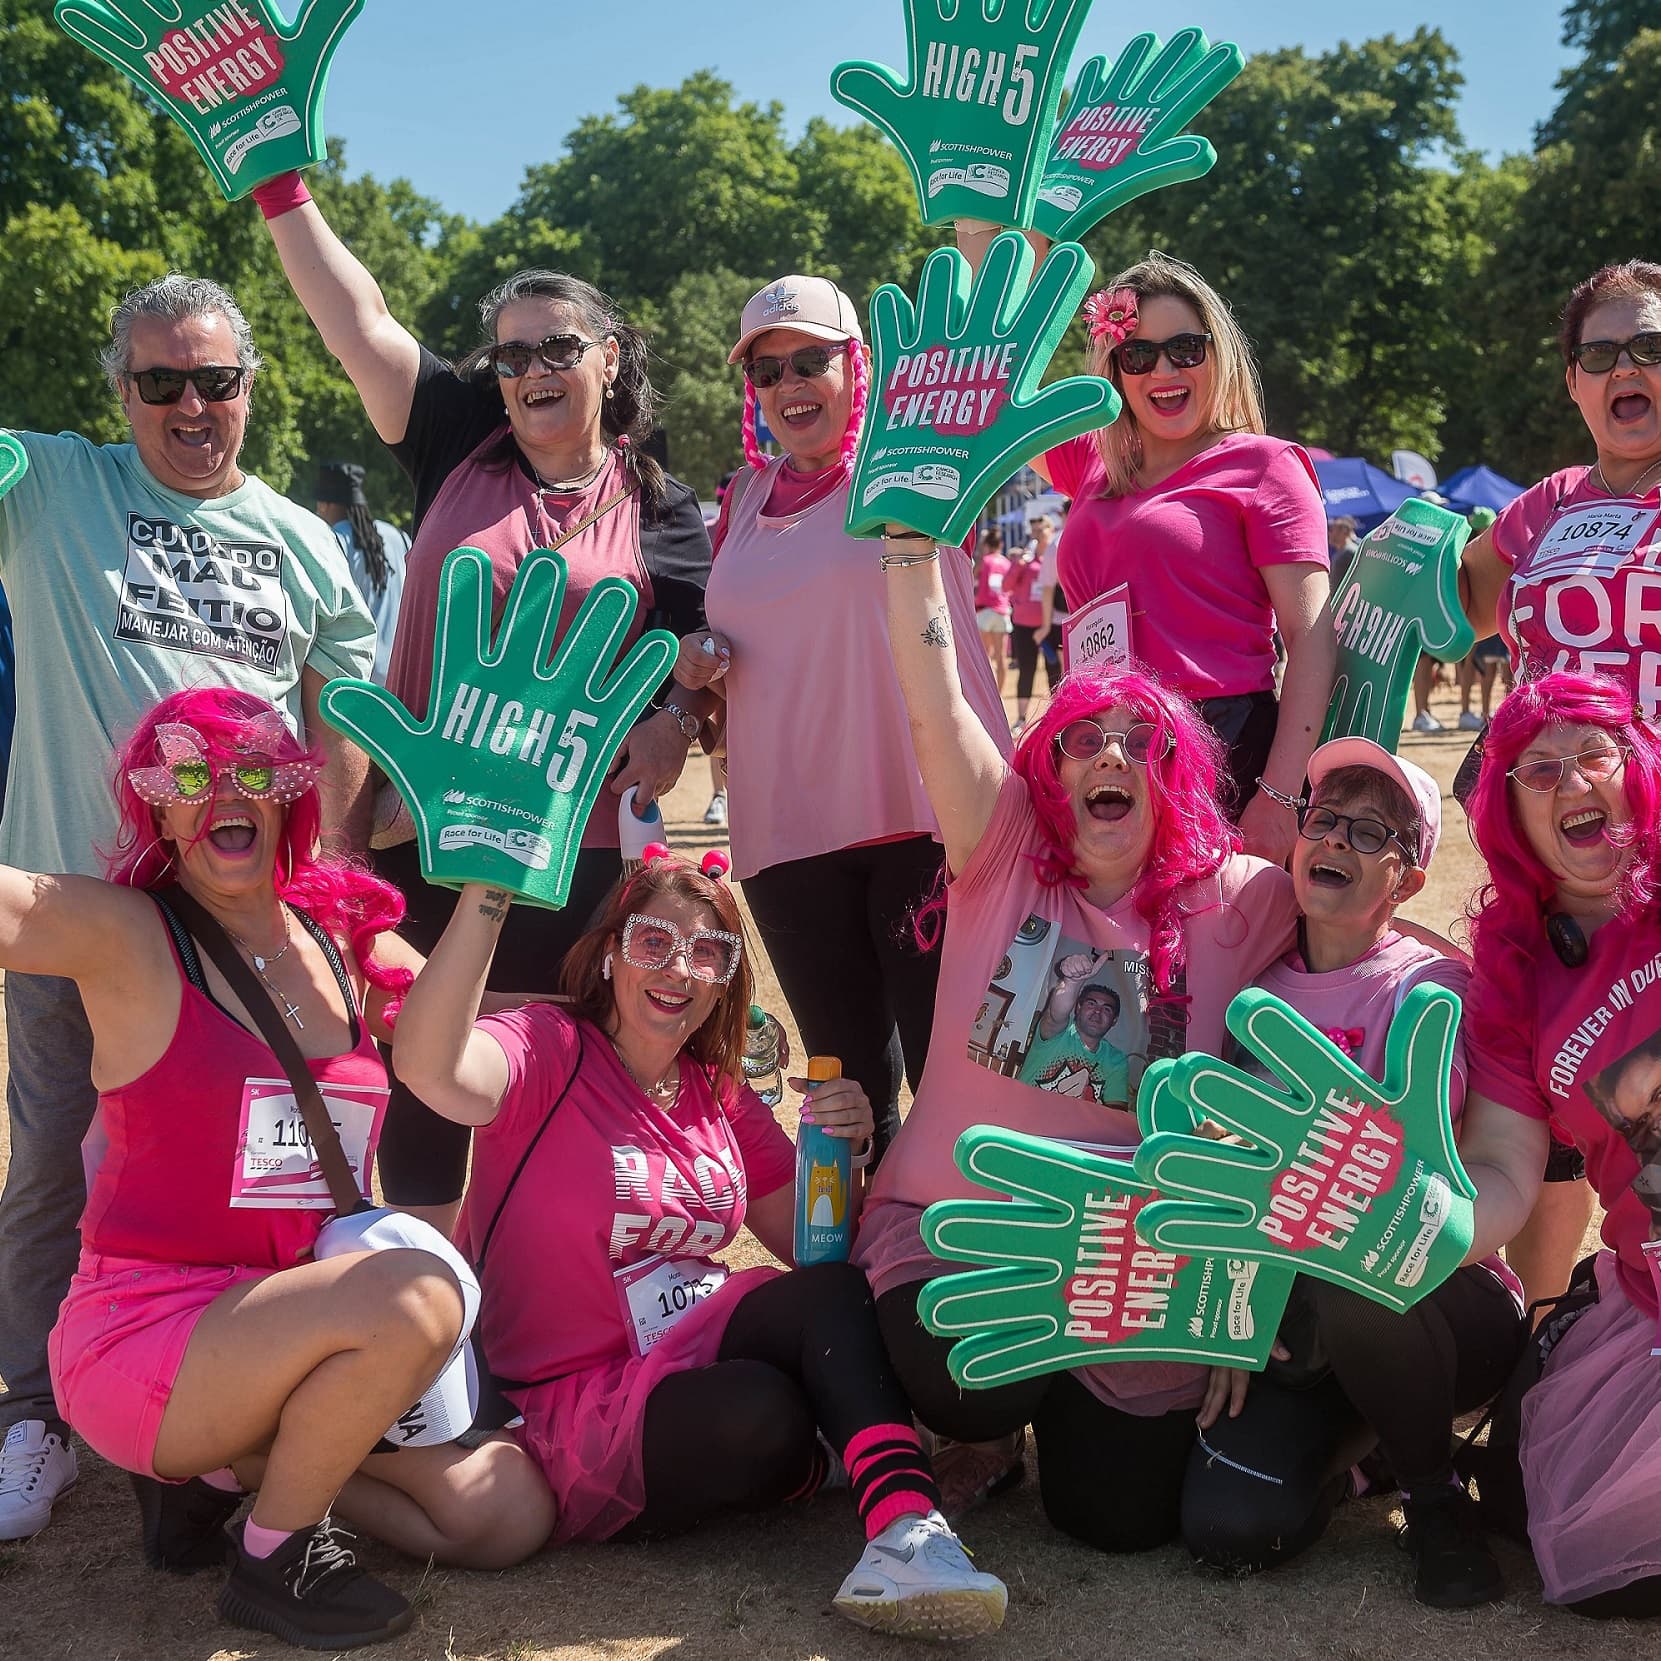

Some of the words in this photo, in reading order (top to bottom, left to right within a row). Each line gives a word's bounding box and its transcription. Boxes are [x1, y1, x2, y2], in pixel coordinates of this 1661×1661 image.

[143, 0, 261, 85] POSITIVE
[181, 37, 277, 115] ENERGY
[923, 41, 1006, 106] HIGH
[222, 87, 289, 128] SCOTTISHPOWER
[1067, 106, 1160, 133] POSITIVE
[246, 133, 260, 144] Life
[939, 143, 1014, 161] SCOTTISHPOWER
[1052, 135, 1132, 164] ENERGY
[949, 171, 963, 180] Life
[763, 303, 801, 317] adidas
[890, 342, 1018, 390] POSITIVE
[886, 388, 996, 431] ENERGY
[887, 446, 969, 460] SCOTTISHPOWER
[881, 477, 892, 486] for
[894, 475, 909, 483] Life
[1558, 521, 1633, 543] 10874
[121, 611, 188, 642] MANEJAR
[192, 631, 221, 649] COM
[226, 635, 275, 664] ATENÇÃO
[1081, 623, 1115, 663] 10862
[441, 682, 556, 767] HIGH
[546, 709, 598, 793] 5
[465, 796, 557, 830] SCOTTISHPOWER
[444, 830, 466, 839] Race
[468, 829, 482, 837] for
[484, 831, 502, 844] Life
[1550, 1006, 1614, 1099] FOREVER
[1608, 978, 1634, 1011] IN
[250, 1158, 282, 1168] TESCO
[611, 1145, 747, 1211] RACE
[1257, 1088, 1365, 1243] POSITIVE
[1306, 1119, 1399, 1251] ENERGY
[1377, 1159, 1424, 1252] SCOTTISHPOWER
[608, 1213, 726, 1259] FOR
[811, 1233, 844, 1244] MEOW
[1400, 1263, 1414, 1283] Race
[1411, 1248, 1422, 1262] for
[1421, 1228, 1434, 1246] Life
[1064, 1192, 1131, 1339] POSITIVE
[1121, 1235, 1177, 1328] ENER
[1233, 1302, 1242, 1314] for
[1235, 1282, 1246, 1299] Life
[1233, 1315, 1242, 1336] Race
